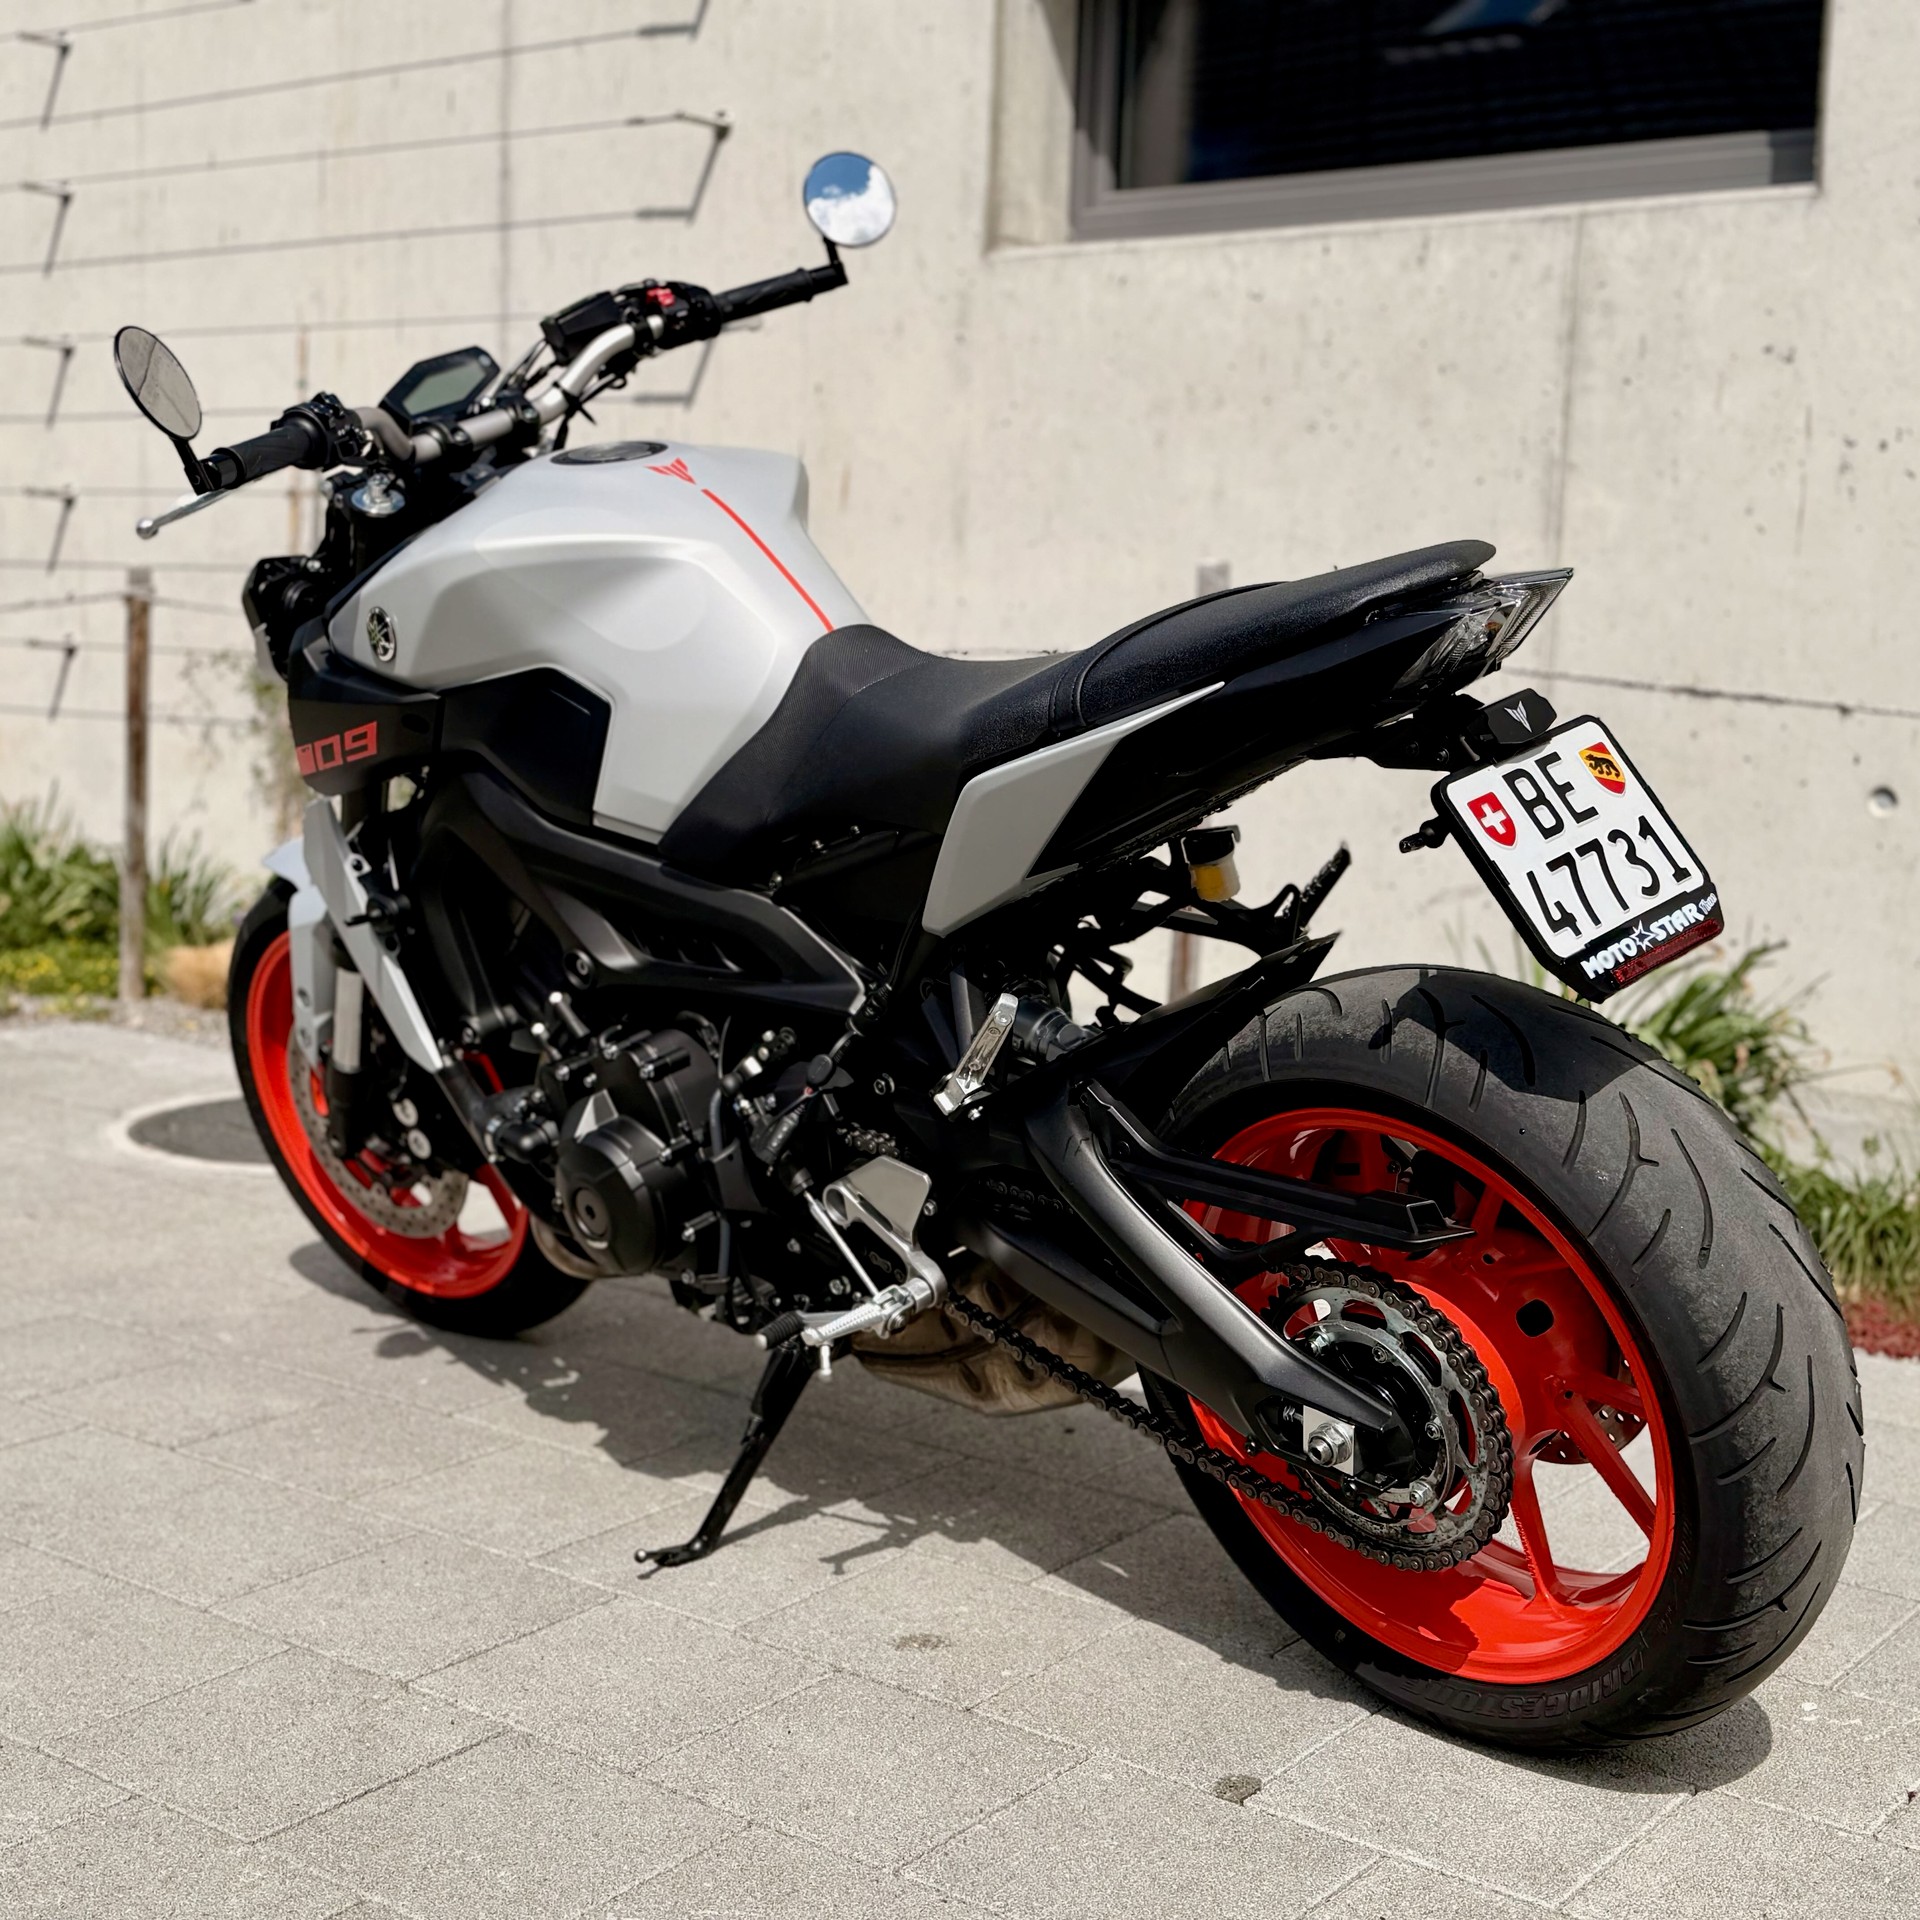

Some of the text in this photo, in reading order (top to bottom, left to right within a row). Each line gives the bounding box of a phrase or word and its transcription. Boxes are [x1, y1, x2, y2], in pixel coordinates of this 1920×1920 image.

[1502, 751, 1599, 840] BE
[1526, 815, 1691, 938] 47731
[1580, 937, 1638, 980] MOTO
[1649, 902, 1705, 942] STAR
[1400, 1649, 1644, 1720] BRIDGESTONE
